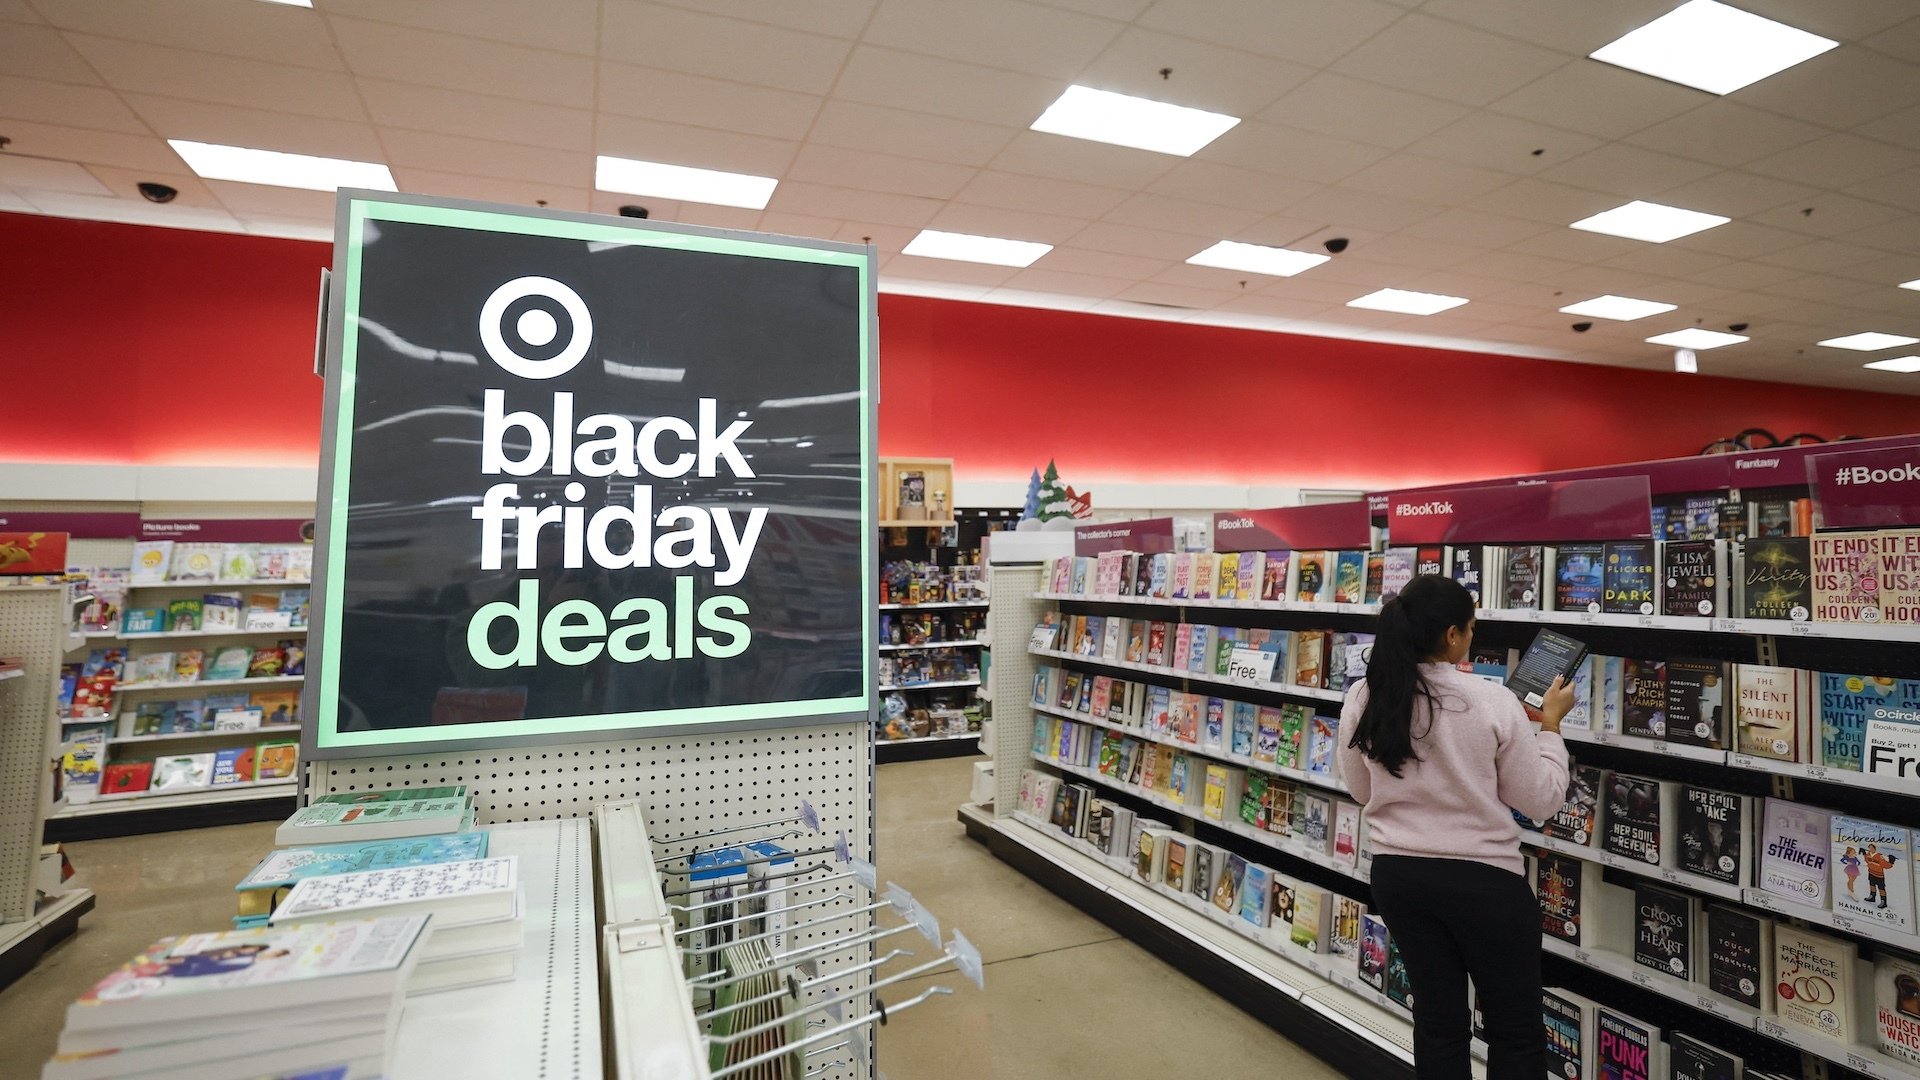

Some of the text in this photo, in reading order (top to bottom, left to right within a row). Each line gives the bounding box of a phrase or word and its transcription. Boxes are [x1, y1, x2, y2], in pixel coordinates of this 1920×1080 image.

[481, 388, 756, 478] black
[1735, 457, 1781, 470] Fantasy
[1396, 501, 1454, 517] #BookTok
[1687, 500, 1717, 509] LOUISE
[143, 523, 200, 531] Picture books
[1218, 518, 1255, 530] #BookTok
[471, 481, 770, 586] friday
[1077, 529, 1131, 540] The collector's corner
[1814, 537, 1879, 555] IT ENDS
[1882, 536, 1898, 553] IT
[1456, 549, 1470, 562] ONE
[1677, 552, 1704, 564] LISA
[1463, 562, 1472, 571] BY
[1607, 565, 1653, 573] FLICKER
[1667, 564, 1715, 578] JEWELL
[1814, 557, 1860, 573] WITH
[1464, 570, 1479, 583] ONE
[1746, 566, 1812, 588] Verity
[1815, 574, 1838, 590] US
[1883, 574, 1909, 591] US
[1605, 589, 1652, 601] DARK
[1677, 591, 1712, 600] FAMILY
[1828, 595, 1870, 605] COLLEEN
[1750, 608, 1787, 617] HOOV
[1755, 601, 1799, 609] COLLEEN
[1818, 605, 1861, 620] HOOV
[127, 619, 154, 631] FART
[248, 618, 275, 629] Free
[466, 575, 752, 669] deals
[1030, 635, 1044, 649] Free
[1229, 661, 1256, 679] Free
[1633, 677, 1665, 689] FILTHY
[1670, 680, 1700, 688] FORGIVING
[1756, 677, 1773, 686] THE
[1824, 676, 1839, 691] IT
[1638, 687, 1665, 699] RICH
[1742, 689, 1788, 703] SILENT
[1903, 683, 1919, 699] IT
[1629, 695, 1665, 709] VAMPIR
[1739, 705, 1792, 721] PATIENT
[1823, 710, 1865, 729] WITH
[216, 720, 245, 731] Free
[1873, 723, 1897, 732] Books,
[1871, 738, 1886, 747] Buy
[1688, 789, 1737, 811] HER SOUL
[1701, 804, 1727, 822] TAKE
[1559, 811, 1588, 832] WITCH
[1614, 823, 1656, 844] HER SOUL
[1835, 827, 1902, 845] Icebreaker
[1778, 835, 1798, 849] THE
[1767, 843, 1825, 870] STRIKER
[1767, 876, 1785, 887] ANA
[1540, 899, 1573, 919] PRINCE
[1641, 904, 1683, 928] CROSS
[1838, 901, 1874, 916] HANNAH
[1641, 930, 1684, 954] HEART
[1719, 938, 1752, 954] TOUCH
[1797, 941, 1816, 953] THE
[1713, 952, 1758, 973] DARKNESS
[1780, 944, 1839, 969] PERFECT
[1781, 954, 1839, 980] MARRIAGE
[1783, 1009, 1816, 1025] JENEVA
[1601, 1016, 1648, 1047] PENELOPE DOUGLAS
[1600, 1030, 1648, 1076] PUNK
